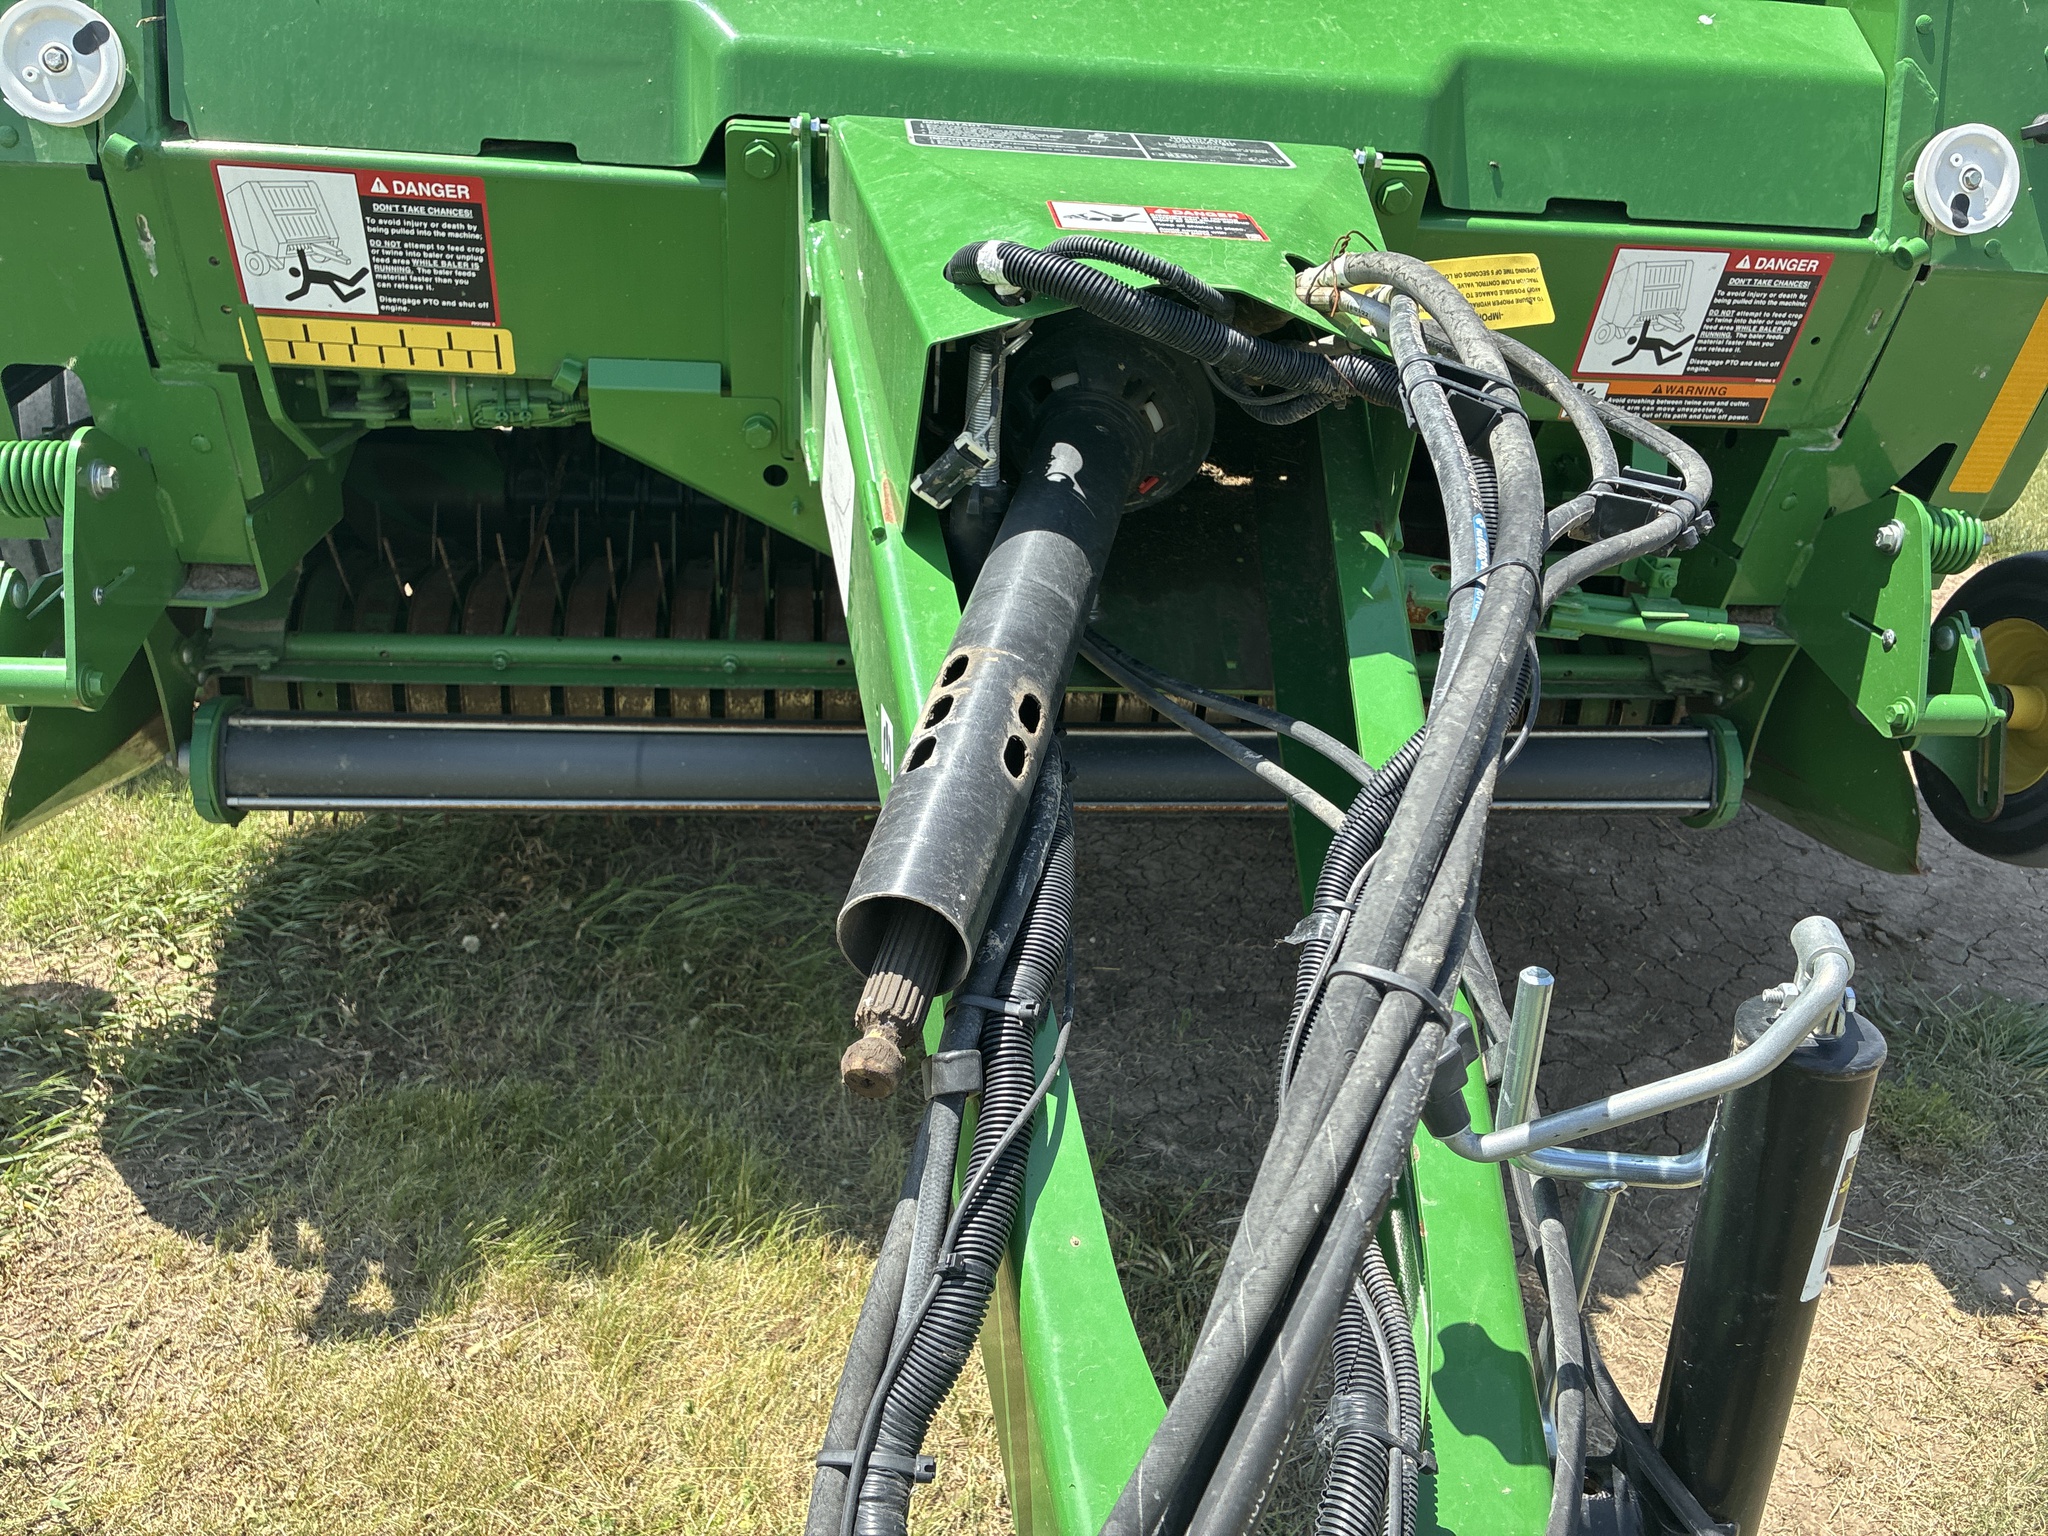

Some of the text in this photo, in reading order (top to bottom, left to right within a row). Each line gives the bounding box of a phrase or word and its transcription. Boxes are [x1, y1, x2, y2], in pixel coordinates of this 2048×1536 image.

[392, 180, 470, 200] DANGER
[372, 203, 473, 218] DON'T TAKE CHANCES!
[378, 218, 400, 226] avoid
[403, 219, 427, 229] injury
[441, 221, 465, 230] death
[467, 224, 477, 232] by
[367, 226, 389, 235] being
[390, 227, 415, 236] pulled
[416, 229, 432, 237] into
[433, 230, 446, 238] the
[369, 239, 485, 254] DO NOT attempt to feed crop
[381, 249, 403, 257] twine
[405, 250, 421, 258] into
[423, 251, 443, 259] baler
[456, 253, 484, 263] unplug
[372, 256, 390, 264] feed
[412, 259, 438, 268] WHILE
[441, 260, 469, 270] BALER
[471, 262, 480, 271] IS
[1755, 257, 1819, 272] DANGER
[416, 267, 431, 275] The
[433, 268, 453, 276] baler
[454, 269, 476, 277] feeds
[1463, 270, 1490, 278] SECONDS
[375, 273, 469, 286] material faster than you
[1727, 278, 1811, 289] DON'T TAKE CHANCES!
[1713, 297, 1731, 305] being
[1747, 291, 1767, 299] injury
[379, 296, 489, 309] Disengage PTO and shut off
[1708, 309, 1719, 317] DO
[1736, 310, 1762, 318] attempt
[1735, 325, 1757, 333] WHILE
[1758, 326, 1782, 334] BALER
[1689, 358, 1724, 367] Disengage
[1665, 385, 1727, 396] WARNING
